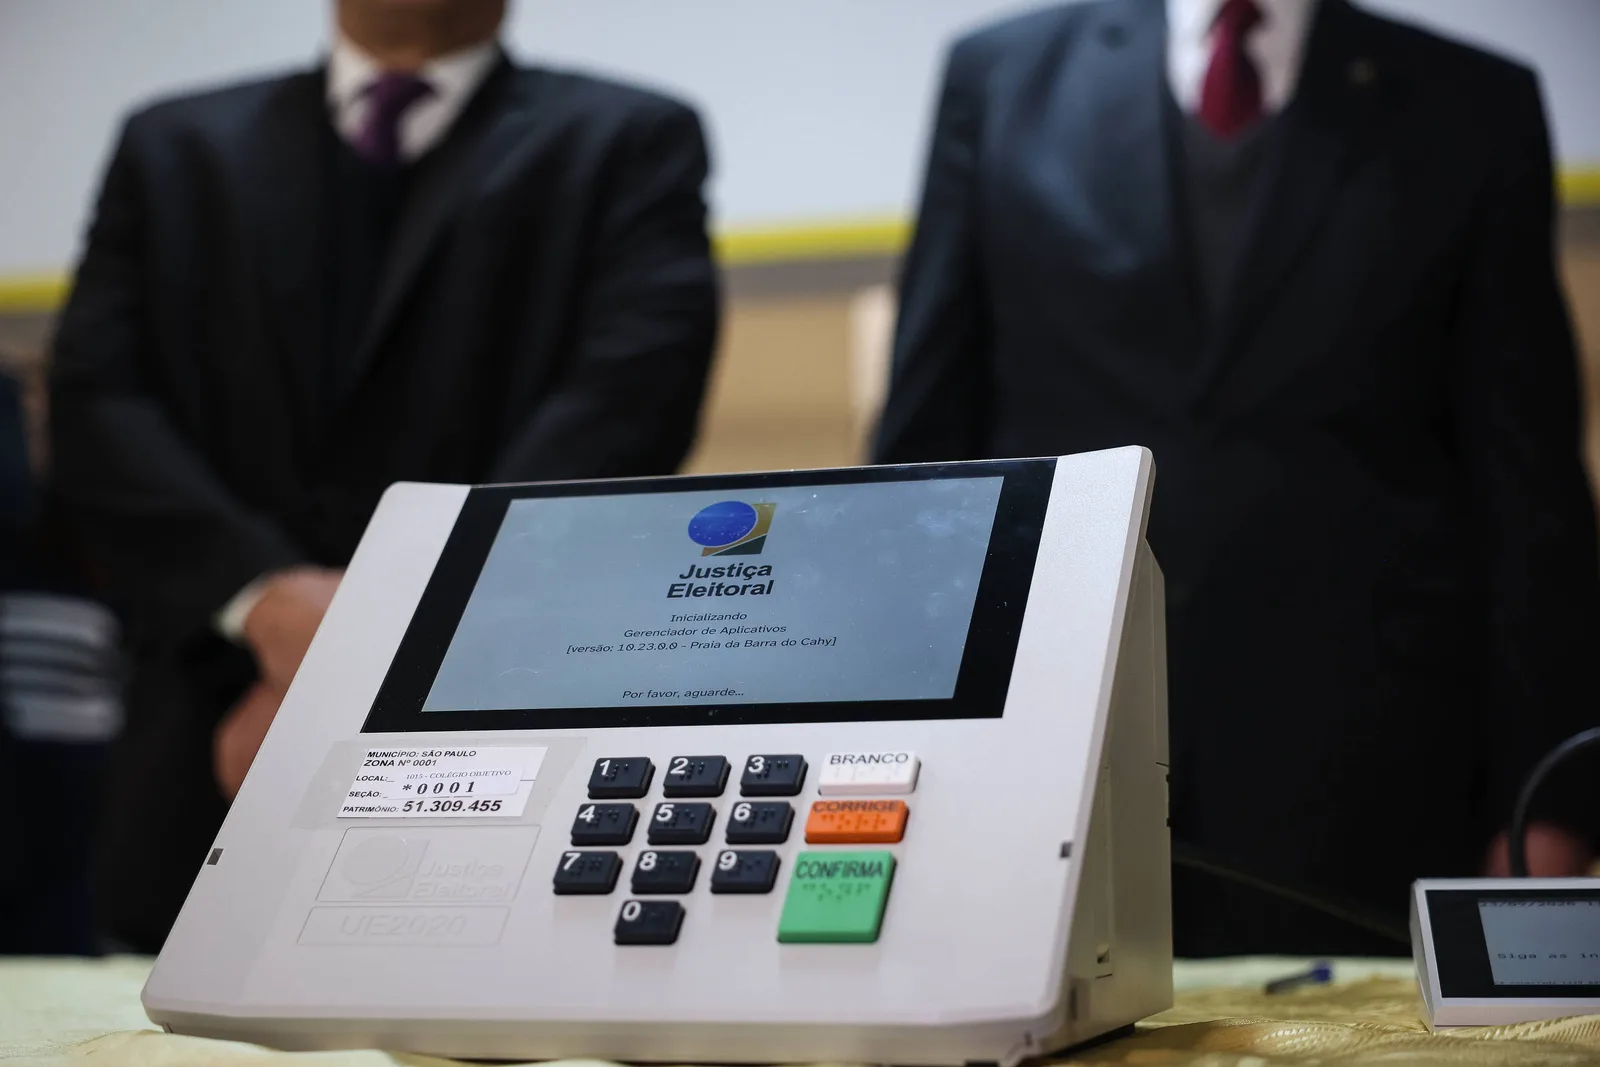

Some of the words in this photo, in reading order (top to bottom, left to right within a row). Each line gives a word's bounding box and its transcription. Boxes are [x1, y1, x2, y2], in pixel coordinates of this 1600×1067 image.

[679, 563, 772, 581] Justiça
[667, 579, 775, 598] Eleitoral
[670, 612, 748, 623] Inicializando
[624, 627, 699, 638] Gerenciador
[701, 626, 717, 635] de
[720, 624, 787, 636] Aplicativos
[566, 644, 614, 655] [versão:
[617, 642, 678, 652] 10.23.0.0
[690, 640, 721, 650] Praia
[725, 640, 740, 649] da
[744, 638, 777, 648] Barra
[781, 638, 797, 647] do
[801, 636, 838, 648] Cahy]
[622, 690, 644, 699] Por
[647, 689, 680, 699] favor,
[684, 688, 744, 700] aguarde...
[367, 750, 419, 758] MUNICÍPIO:
[444, 750, 477, 758] PAULO
[829, 753, 909, 766] BRANCO
[363, 759, 395, 767] ZONA
[413, 759, 438, 767] 0001
[599, 760, 611, 776] 1
[669, 758, 689, 775] 2
[748, 757, 765, 773] 3
[430, 771, 468, 779] COLÉGIO
[469, 770, 512, 778] OBJETIVO
[348, 790, 382, 798] SEÇÃO:
[342, 804, 400, 812] PATRIMÔNIO:
[402, 800, 503, 813] 51.309.455
[578, 805, 596, 822] 4
[655, 803, 675, 821] 5
[733, 803, 752, 820] 6
[812, 801, 898, 812] CORRIGE
[563, 853, 582, 871] 7
[638, 852, 658, 870] 8
[719, 852, 738, 870] 9
[795, 860, 884, 879] CONFIRMA
[622, 901, 642, 921] 0
[339, 914, 467, 937] UE2020
